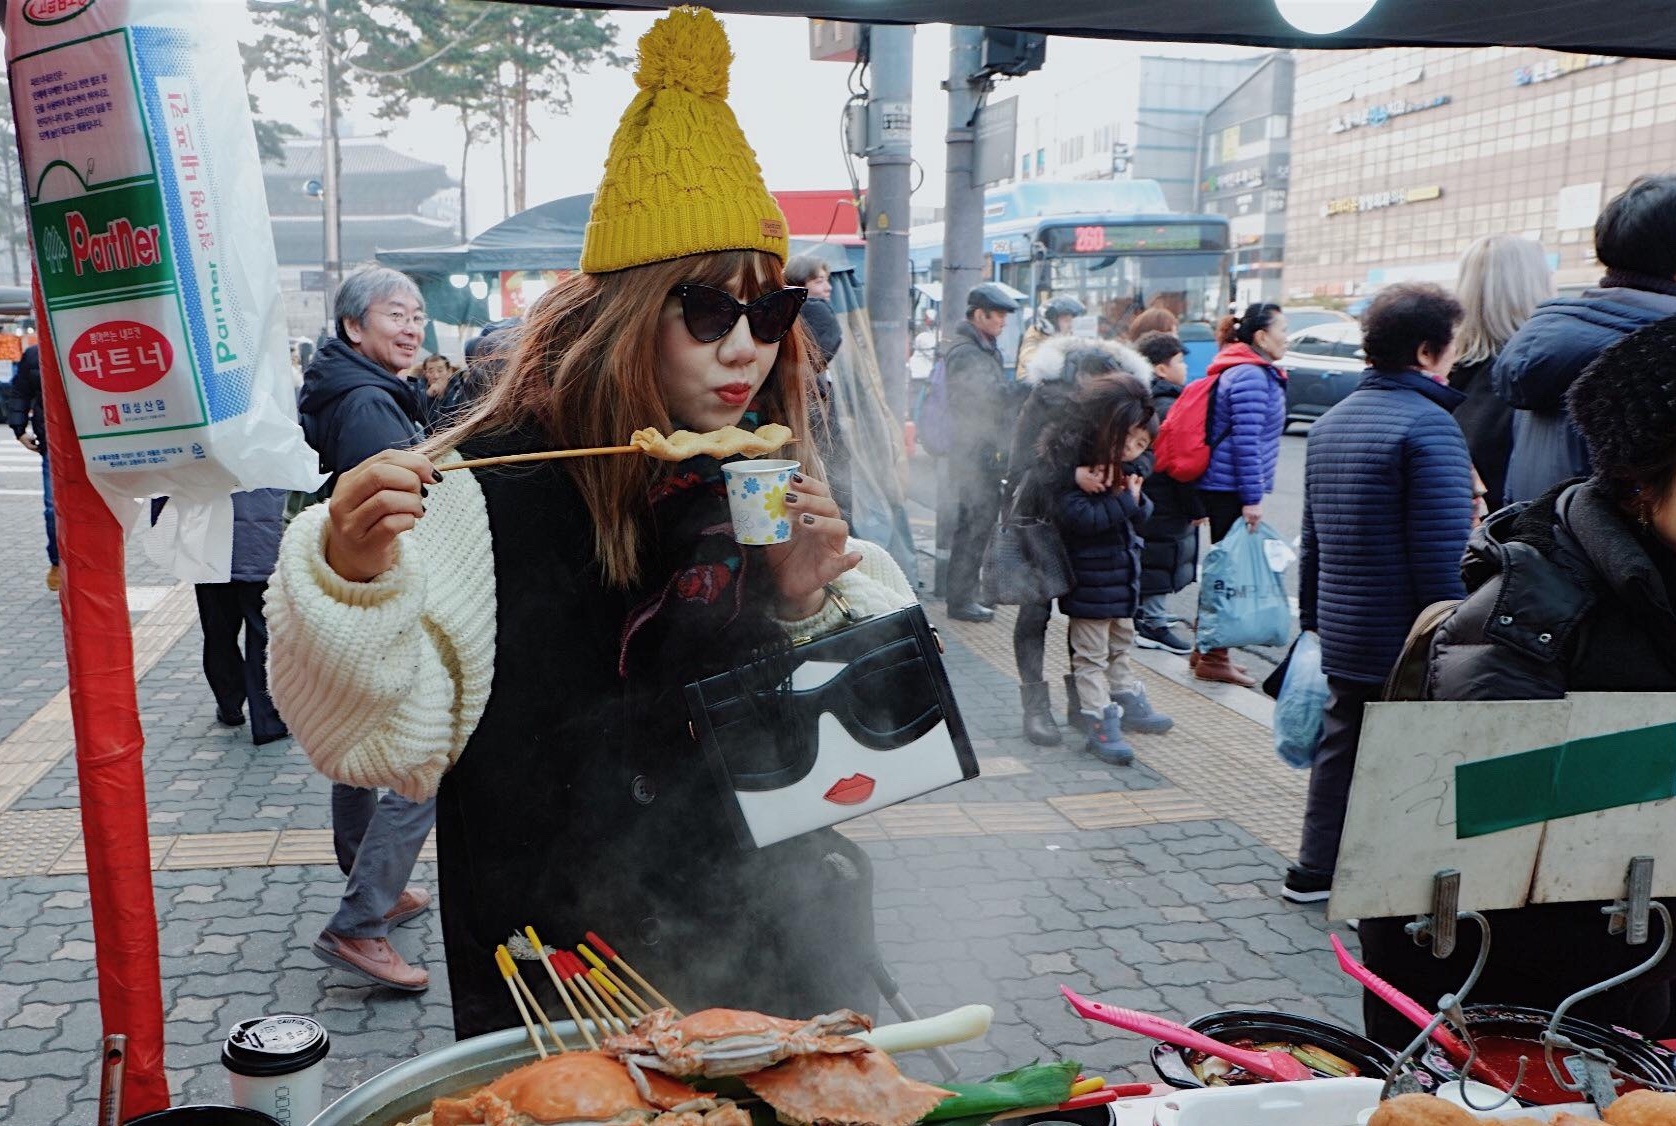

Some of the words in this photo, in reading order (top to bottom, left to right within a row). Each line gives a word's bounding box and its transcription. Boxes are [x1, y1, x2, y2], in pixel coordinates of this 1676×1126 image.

[66, 211, 162, 276] Partner
[1074, 226, 1105, 252] 260
[208, 261, 238, 364] Partner
[76, 341, 167, 379] 파트너
[122, 399, 166, 414] 대성산업
